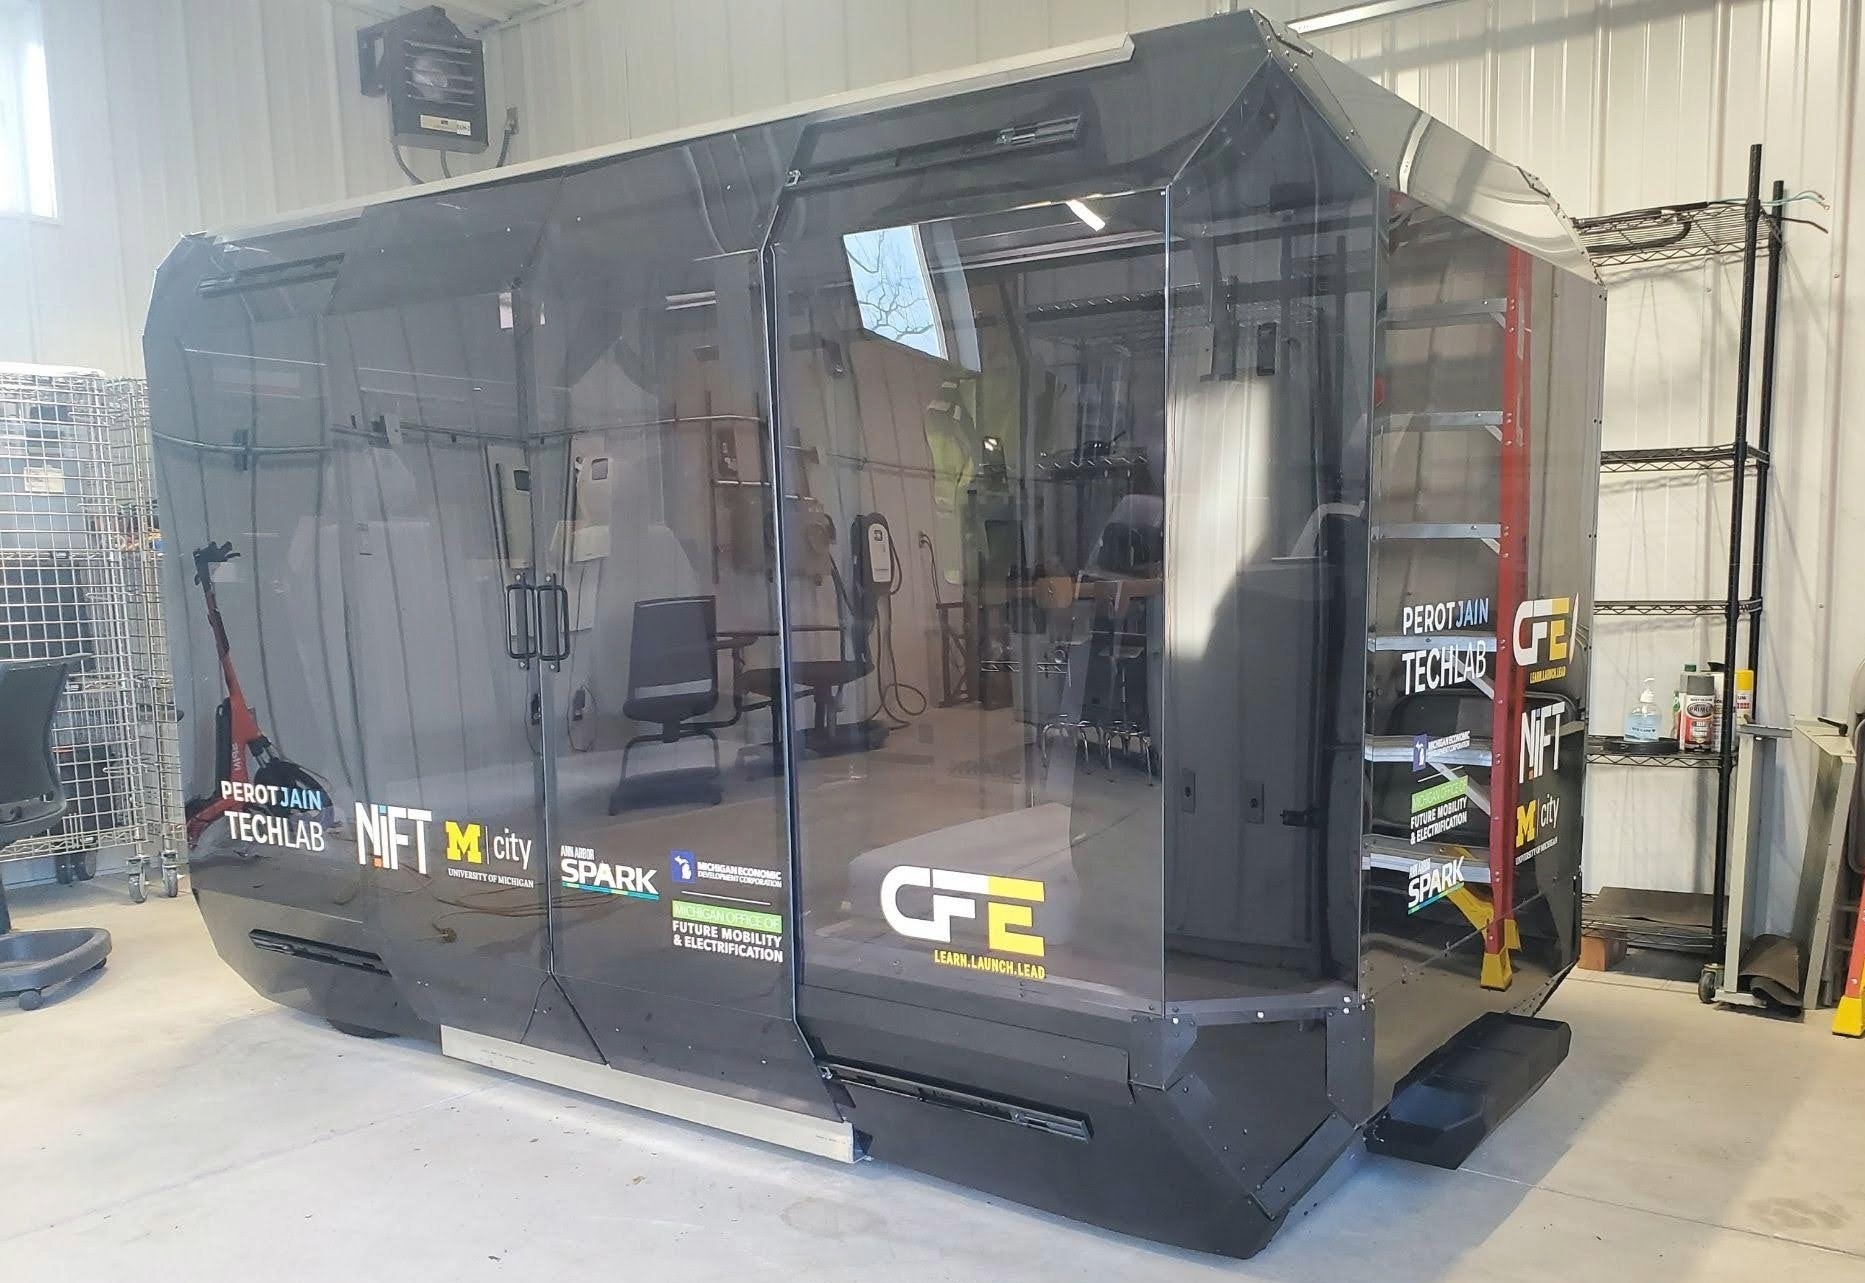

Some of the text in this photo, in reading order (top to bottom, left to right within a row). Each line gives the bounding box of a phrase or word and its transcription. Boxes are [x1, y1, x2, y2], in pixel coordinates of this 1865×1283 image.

[1402, 640, 1486, 695] TECHLAB
[1410, 811, 1468, 845] & ELECTRIFICATION
[1411, 796, 1468, 830] FUTURE MOBILITY
[1516, 793, 1560, 848] M city
[224, 810, 325, 851] TECHLAB
[445, 820, 532, 870] M city
[448, 867, 534, 889] UNIVERSITY OF MICHIGAN
[561, 858, 659, 895] SPARK
[697, 861, 782, 880] MICHIGAN ECONOMIC
[1408, 855, 1464, 908] SPARK
[674, 902, 724, 919] MICHIGAN
[672, 920, 782, 948] FUTURE MOBILITY
[673, 934, 783, 963] & ELECTRIFICATION
